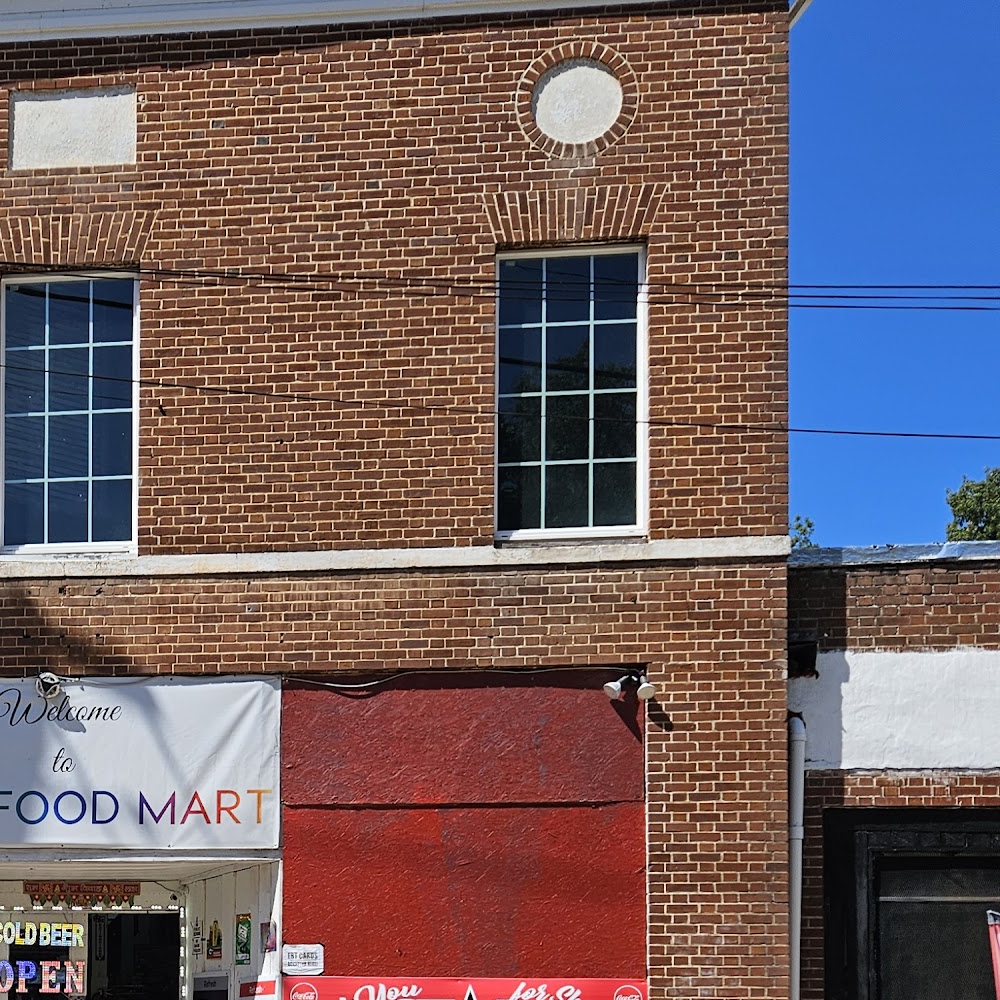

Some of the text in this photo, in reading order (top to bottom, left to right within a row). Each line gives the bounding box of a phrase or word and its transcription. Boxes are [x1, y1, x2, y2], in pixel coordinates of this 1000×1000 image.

[52, 748, 76, 773] to
[139, 789, 273, 825] MART
[39, 922, 85, 947] BEER
